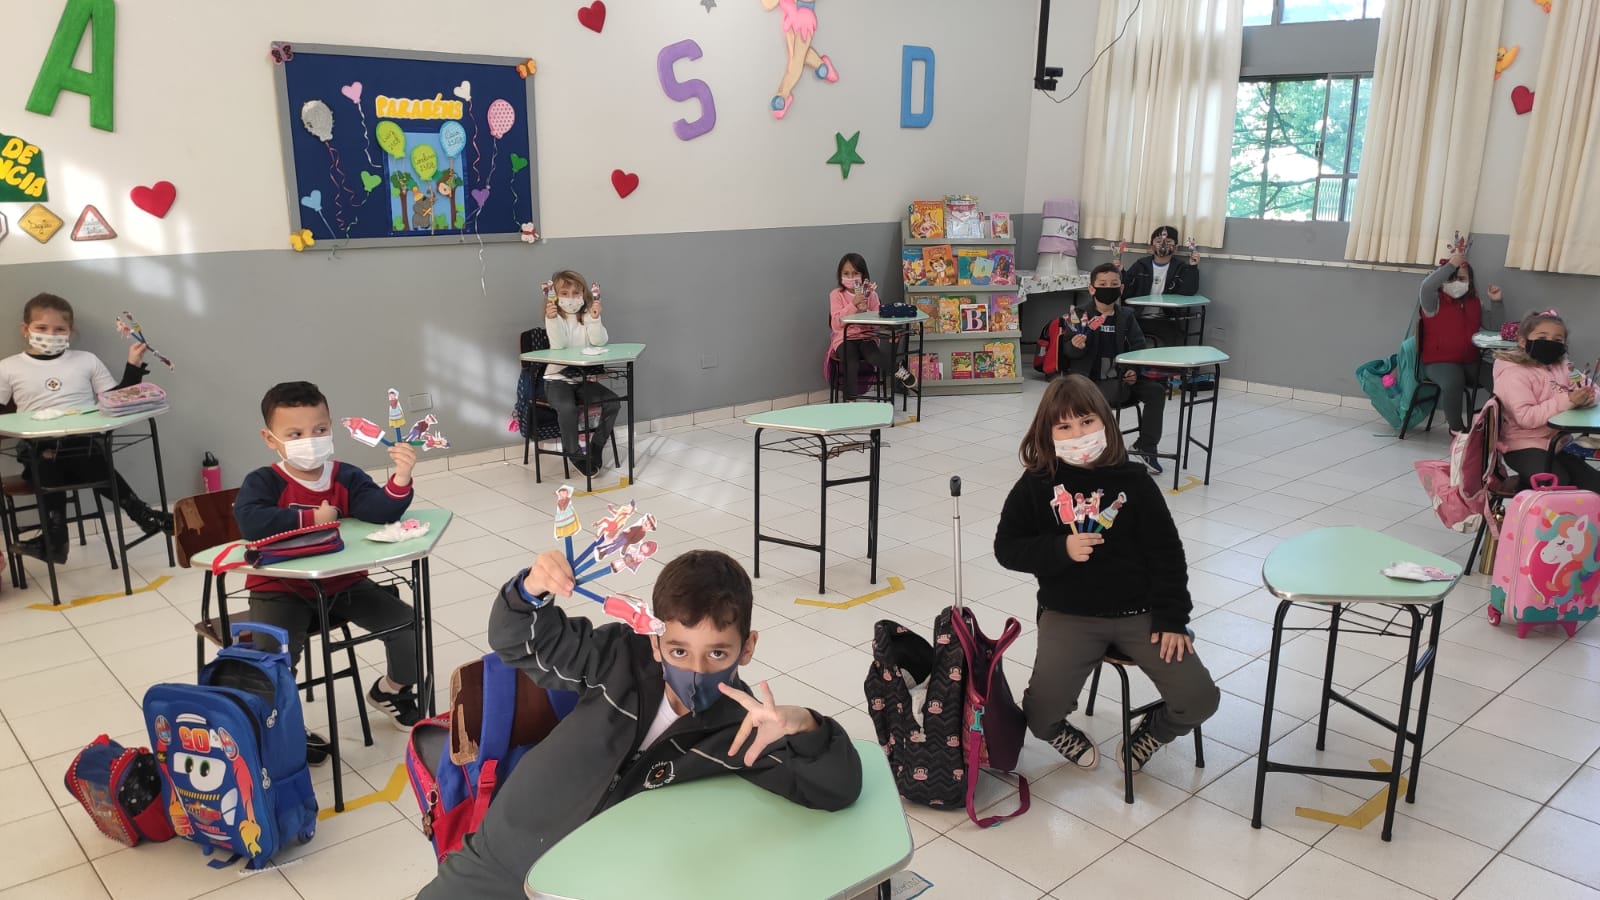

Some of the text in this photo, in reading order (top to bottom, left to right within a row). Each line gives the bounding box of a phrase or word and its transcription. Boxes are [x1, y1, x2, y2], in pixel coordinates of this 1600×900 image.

[25, 0, 115, 132] A
[657, 39, 716, 141] S
[900, 45, 935, 128] D
[376, 93, 463, 119] PARABÉNS
[1, 137, 39, 165] DE
[966, 309, 983, 330] B
